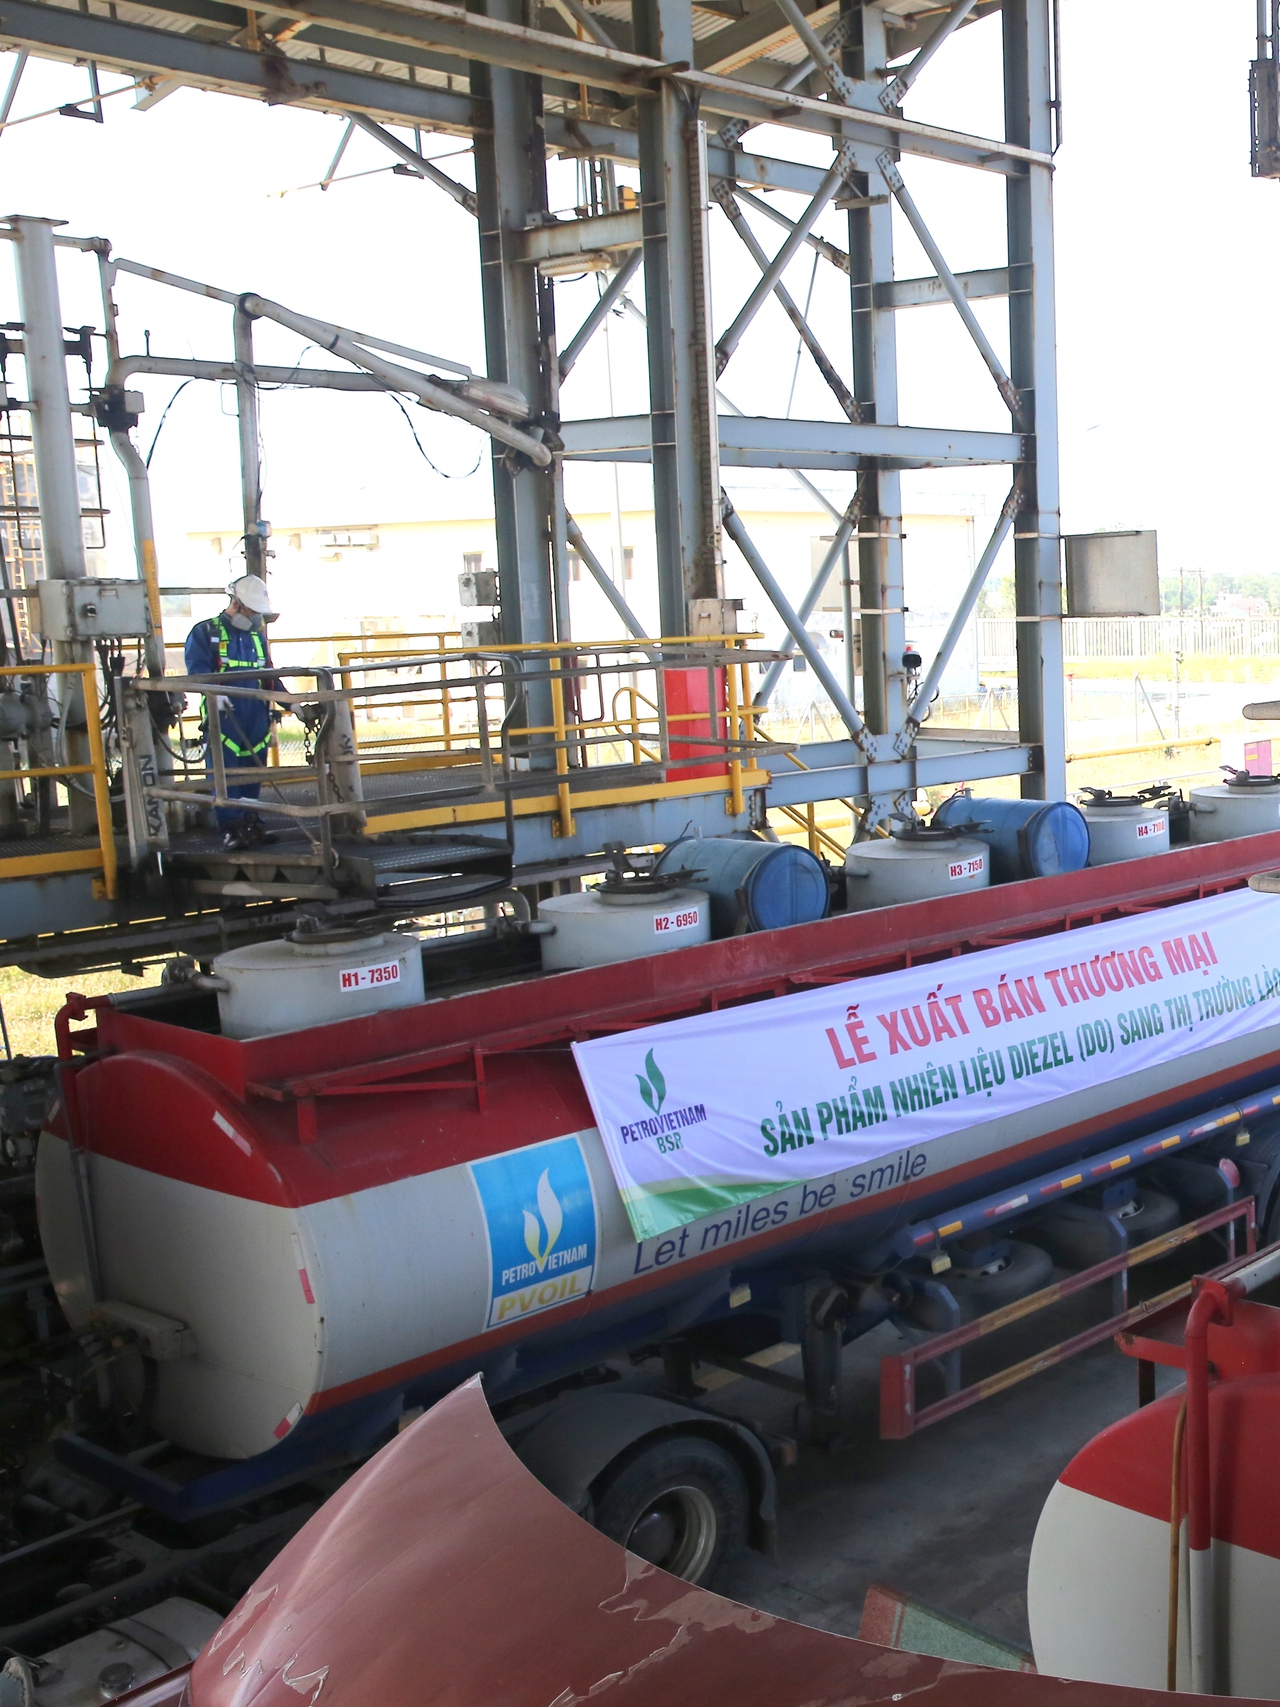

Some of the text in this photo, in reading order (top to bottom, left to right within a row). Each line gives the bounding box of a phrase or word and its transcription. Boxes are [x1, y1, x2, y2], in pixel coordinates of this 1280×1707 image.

[825, 931, 1219, 1070] LỄ XUẤT BÁN THƯƠNG MẠI
[760, 1100, 814, 1158] SẢN
[816, 1076, 888, 1141] PHẨM
[889, 1062, 959, 1117] NHIÊN
[959, 1047, 1006, 1097] LIỆU
[1007, 1031, 1074, 1081] DIEZEL
[1076, 1018, 1115, 1062] (DO)
[1119, 1003, 1164, 1045] SANG
[1164, 995, 1194, 1032] THỊ
[1192, 975, 1255, 1021] TRƯỜNG
[621, 1104, 708, 1145] PETROVIETNAM
[656, 1132, 684, 1154] BSR
[634, 1150, 928, 1275] Let miles be smile
[502, 1243, 587, 1286] PETROVIETNAM
[498, 1275, 581, 1320] PVOIL
